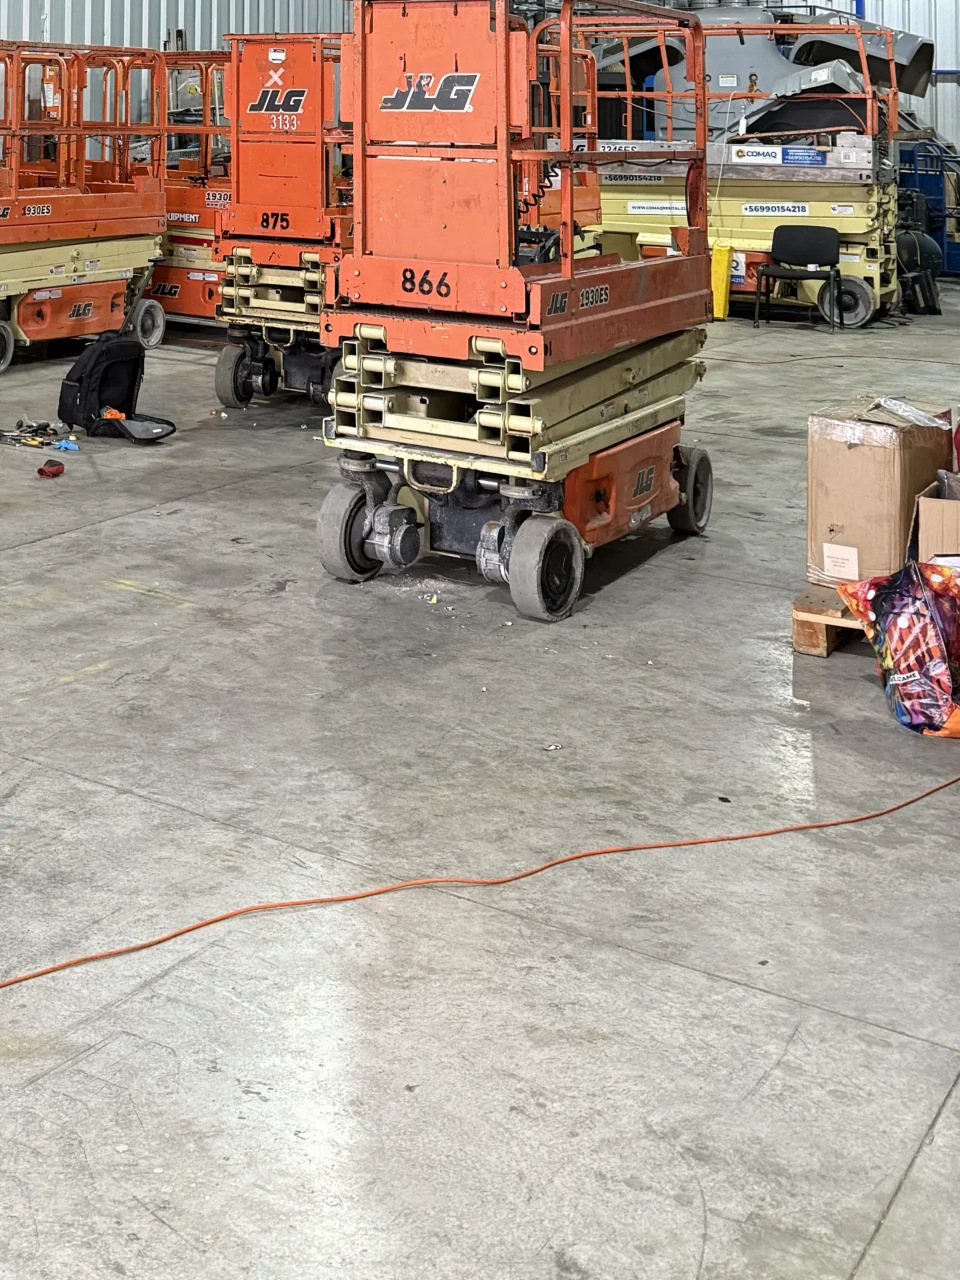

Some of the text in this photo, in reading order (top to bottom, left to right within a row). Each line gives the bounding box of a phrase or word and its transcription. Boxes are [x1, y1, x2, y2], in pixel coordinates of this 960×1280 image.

[246, 88, 309, 114] JLG
[379, 72, 481, 113] JLG
[270, 114, 297, 131] 3133
[746, 149, 777, 159] COMAQ
[604, 174, 663, 182] +56990154218
[21, 204, 52, 217] 1930ES
[744, 205, 807, 213] +56990154218
[260, 212, 290, 230] 875
[151, 282, 181, 299] JLG
[401, 268, 451, 298] 866
[546, 284, 610, 317] JLG 1930ES
[68, 302, 94, 320] JLG
[632, 465, 655, 500] JLG
